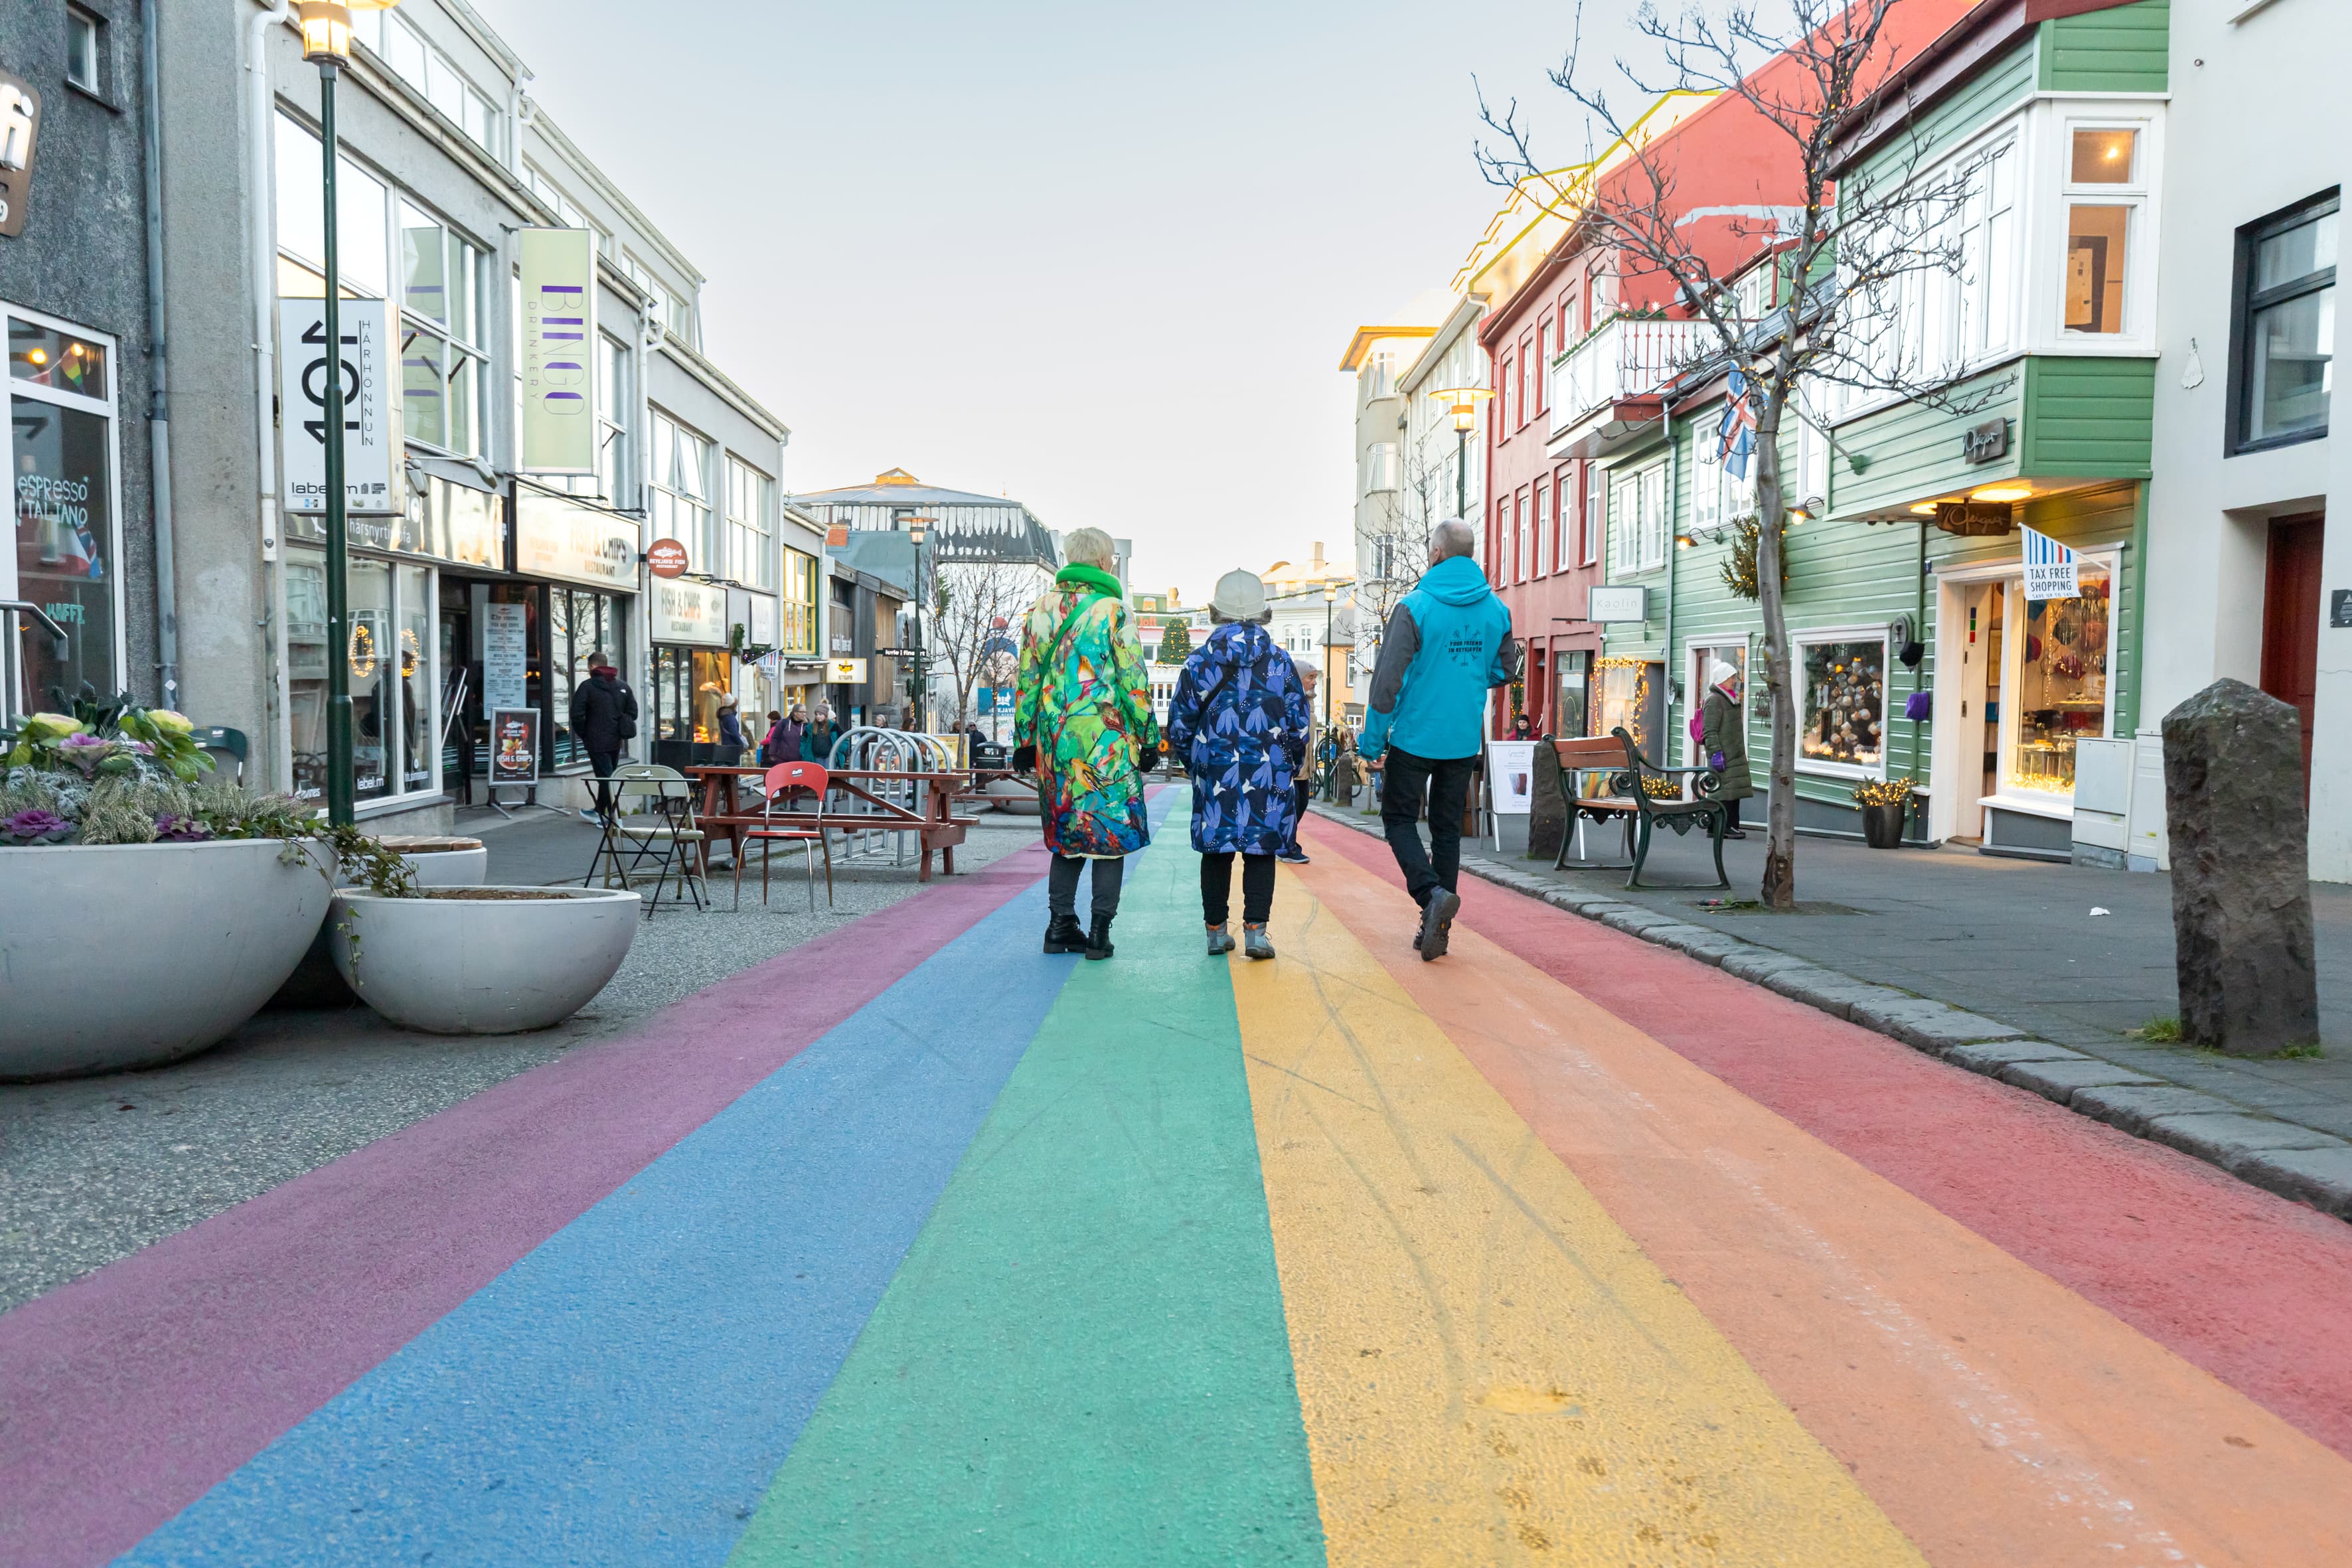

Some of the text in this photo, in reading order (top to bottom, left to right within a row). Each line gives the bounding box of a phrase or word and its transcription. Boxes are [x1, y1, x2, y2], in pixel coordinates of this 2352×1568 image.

[528, 301, 539, 399] DRINKERY
[541, 285, 585, 415] BINGO
[301, 319, 360, 444] 101
[362, 320, 373, 445] HÁRHÖNNUN
[291, 482, 358, 495] labem
[19, 498, 88, 524] ITALIANO
[349, 518, 411, 544] hársnyrtiofa
[602, 526, 627, 563] CHIPS
[584, 560, 615, 578] RESTAURANT
[2029, 567, 2071, 580] TAX FREE
[2031, 581, 2072, 592] SHOPPING
[661, 587, 701, 620] FISH & CHIPS
[1597, 597, 1637, 608] Kaolin
[46, 603, 86, 625] KAFFI
[1139, 615, 1158, 627] loft
[671, 621, 693, 632] RESTAURANT
[357, 776, 384, 790] label.m
